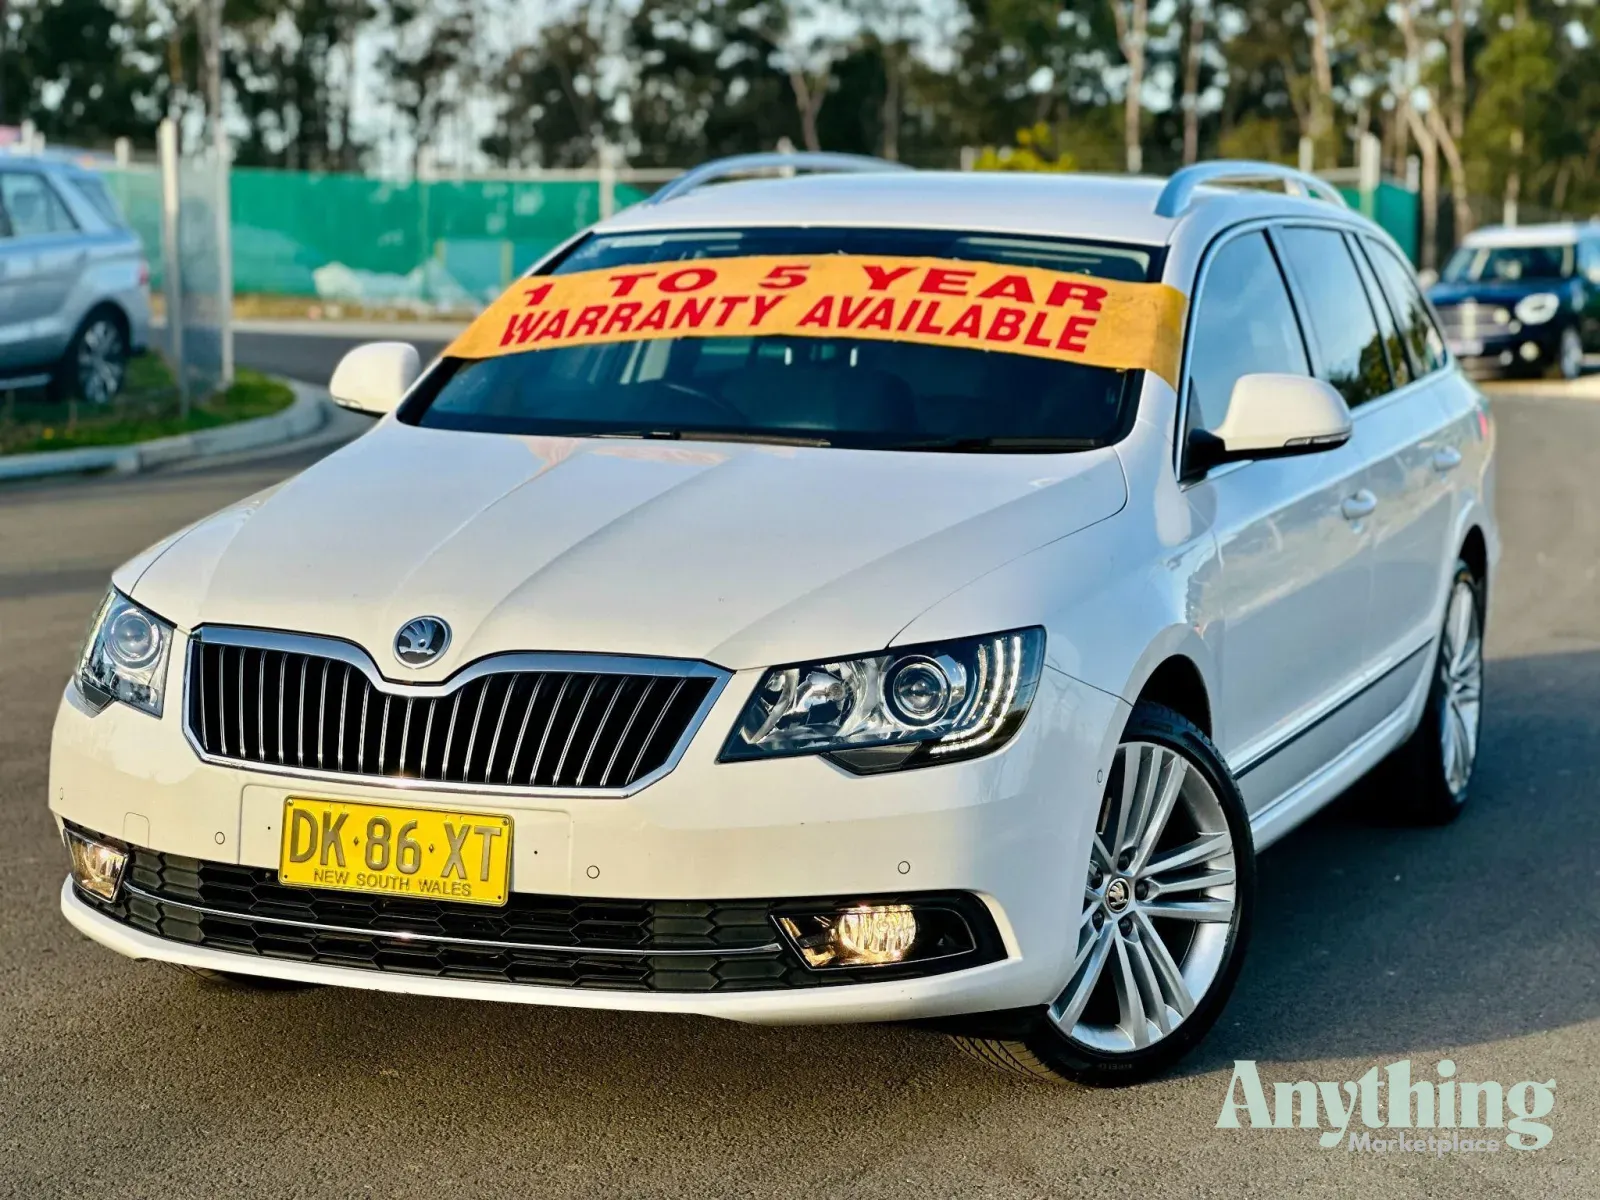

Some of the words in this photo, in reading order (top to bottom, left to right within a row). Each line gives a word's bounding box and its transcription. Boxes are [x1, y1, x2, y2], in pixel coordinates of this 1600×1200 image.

[525, 283, 554, 307] 1
[610, 268, 718, 297] TO
[760, 265, 810, 290] 5
[863, 265, 1108, 312] YEAR
[500, 295, 785, 347] WARRANTY
[797, 295, 1097, 353] AVAILABLE
[313, 868, 351, 885] NEW
[356, 872, 411, 891] SOUTH
[418, 879, 472, 897] WALES
